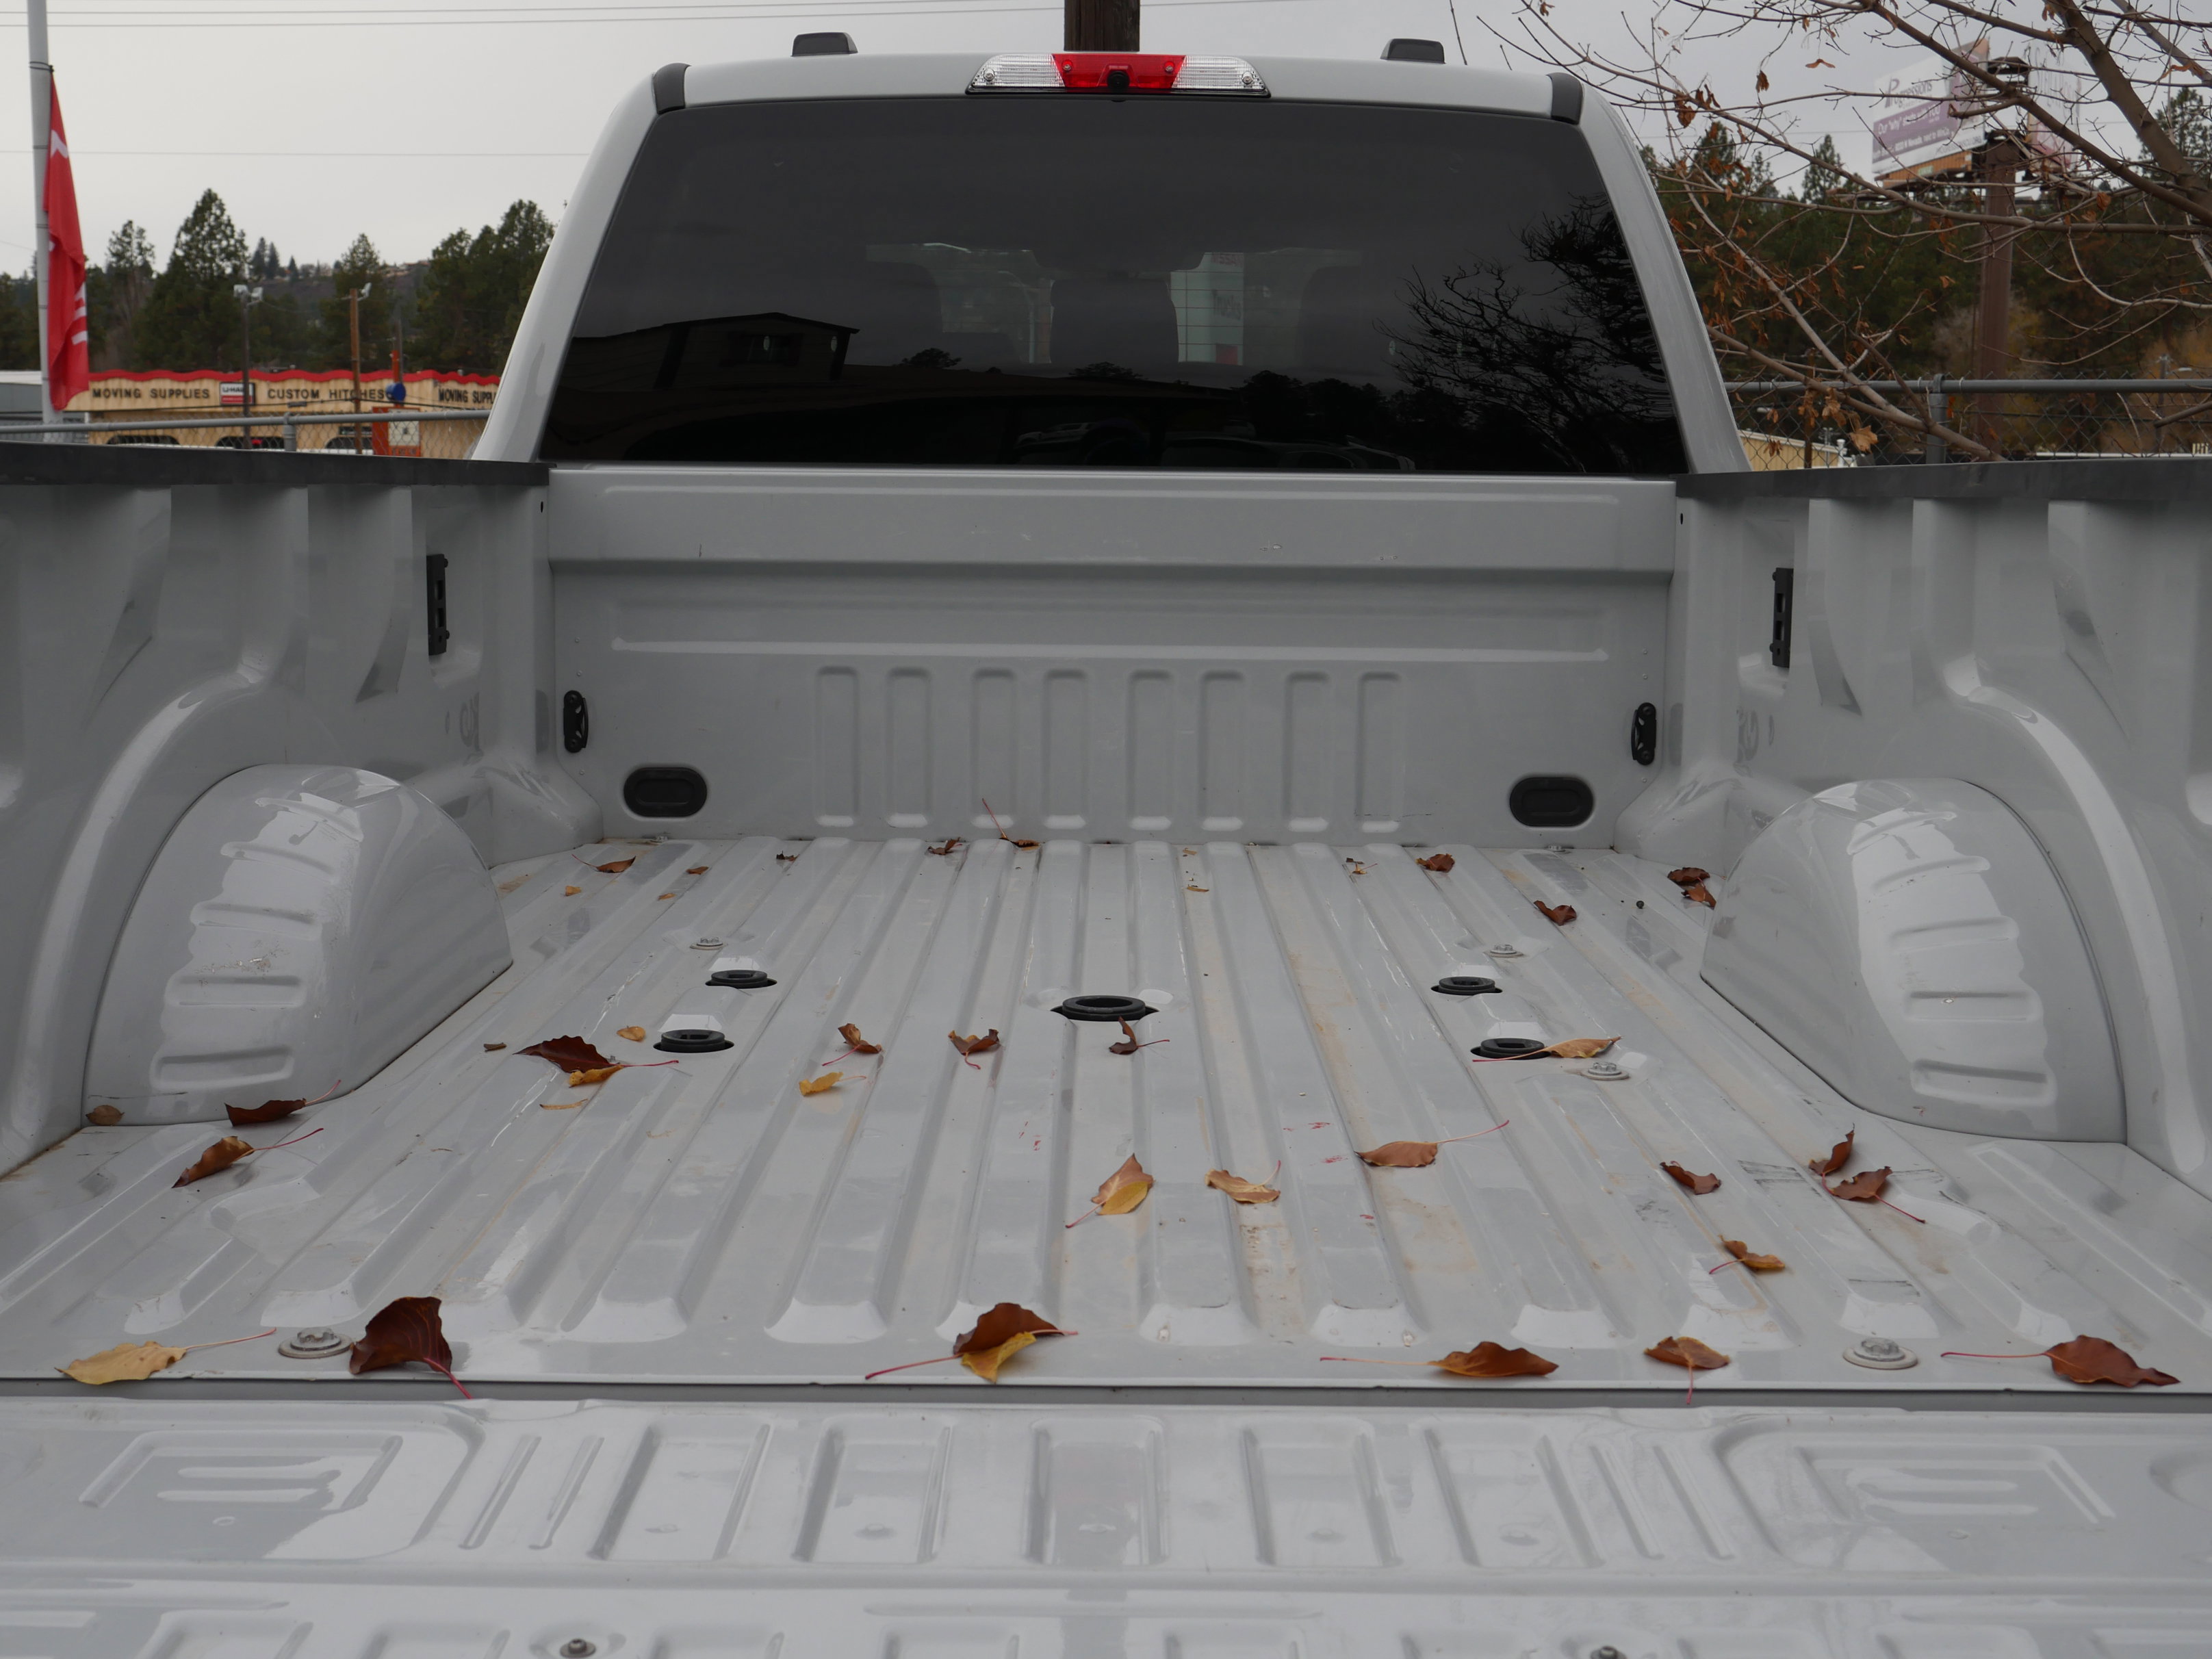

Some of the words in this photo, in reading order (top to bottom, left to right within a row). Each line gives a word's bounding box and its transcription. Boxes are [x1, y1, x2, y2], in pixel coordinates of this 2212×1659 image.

[92, 389, 142, 399] MOVING
[150, 388, 210, 399] SUPPLIES
[268, 388, 320, 399] CUSTOM
[439, 388, 468, 402] MOVING
